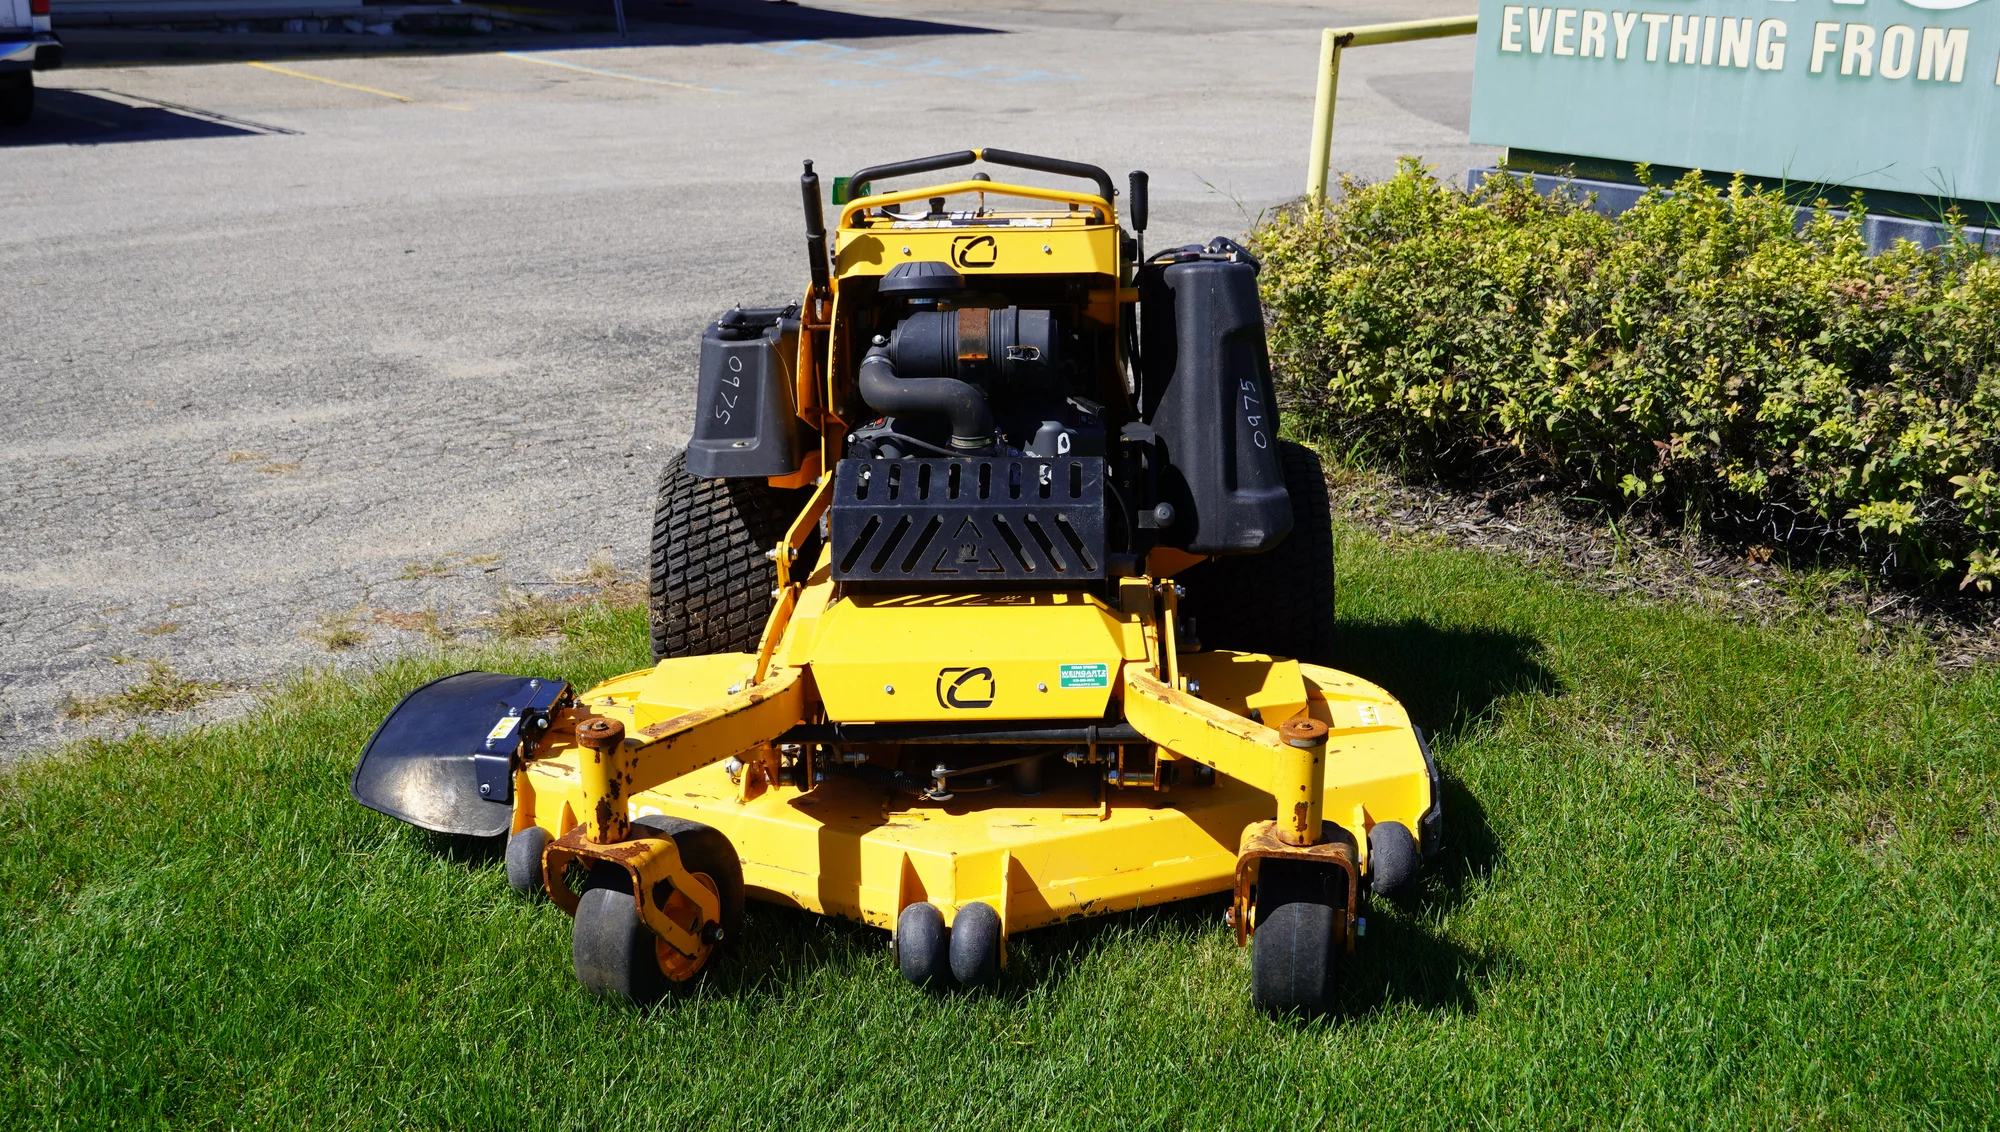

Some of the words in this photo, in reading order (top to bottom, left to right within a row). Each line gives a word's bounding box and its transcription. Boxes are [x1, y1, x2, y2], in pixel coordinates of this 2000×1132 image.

[1500, 6, 1788, 71] EVERYTHING
[1810, 22, 1969, 83] FROM
[715, 356, 742, 425] 0975
[1240, 378, 1267, 449] 0975
